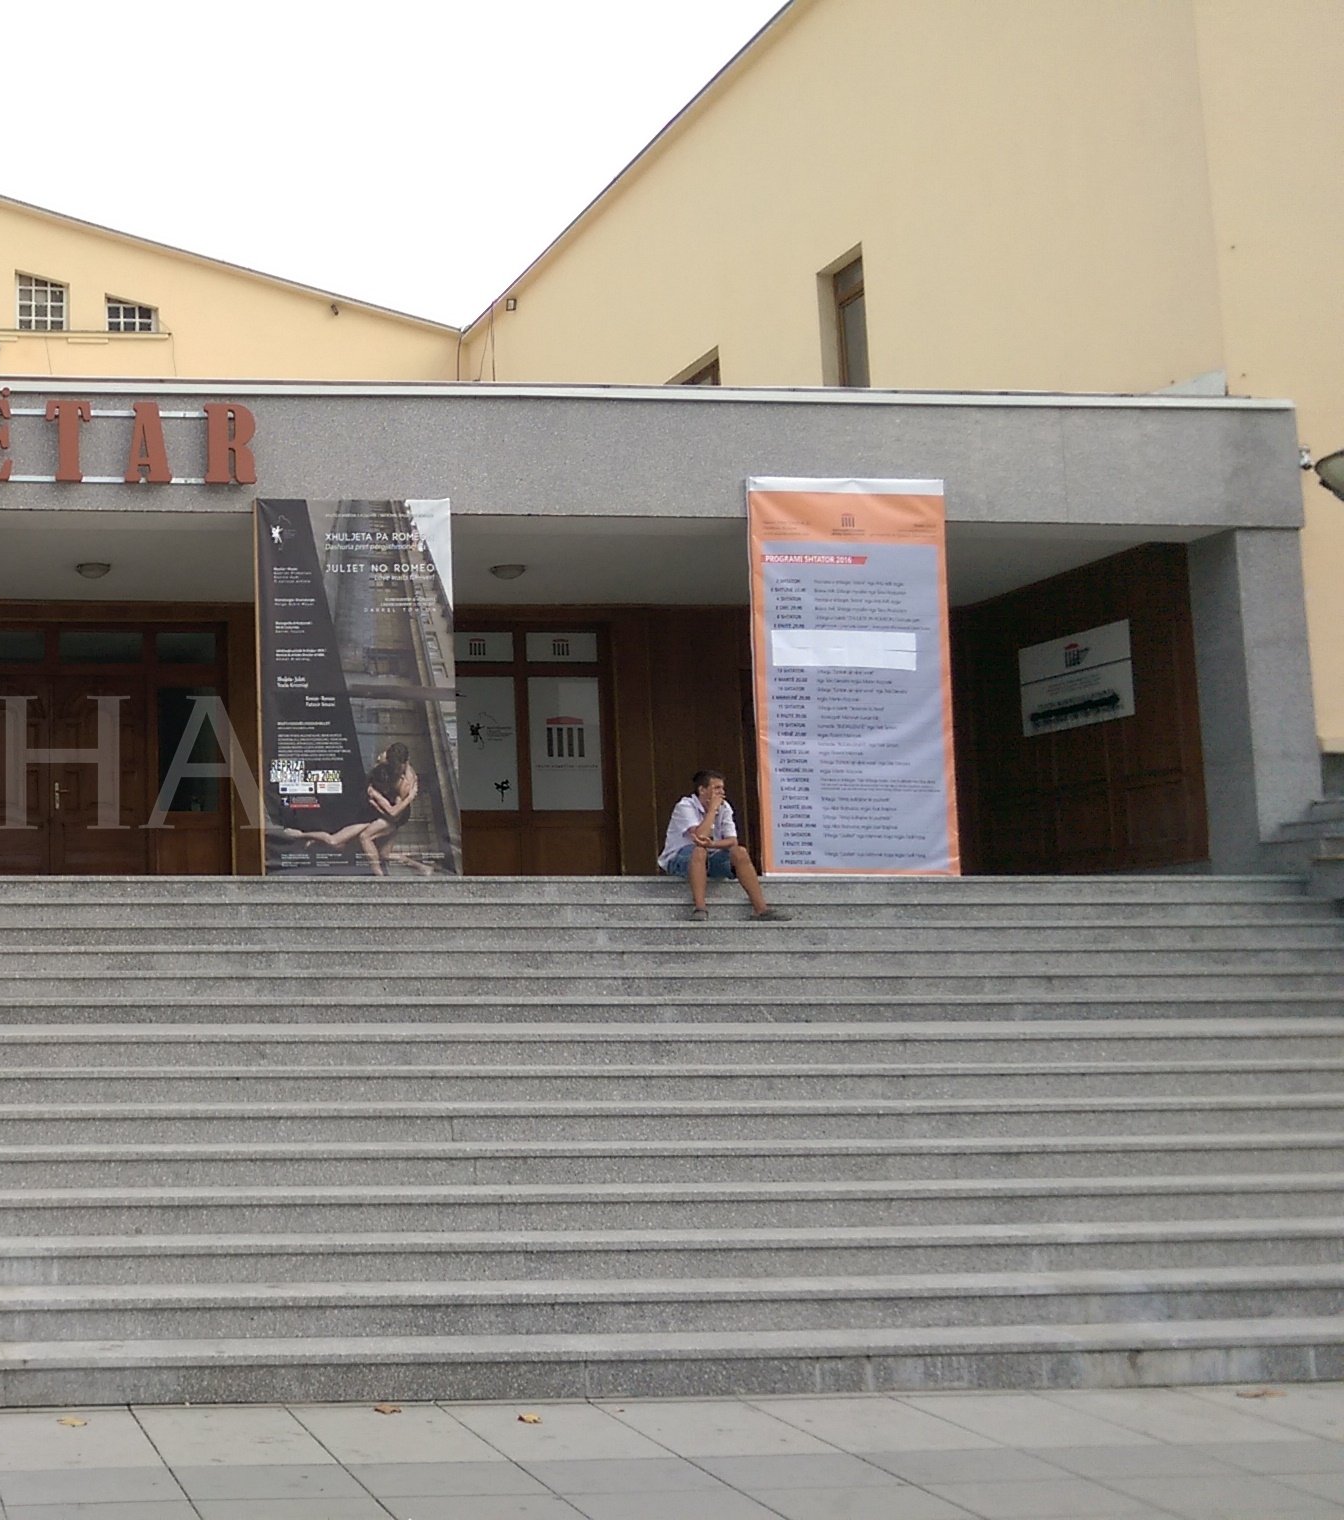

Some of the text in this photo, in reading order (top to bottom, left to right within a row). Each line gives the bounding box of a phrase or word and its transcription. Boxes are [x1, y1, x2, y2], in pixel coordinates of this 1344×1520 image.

[325, 532, 372, 541] XHULJETA
[376, 532, 388, 541] PA
[325, 563, 435, 573] JULIET NO ROMEO
